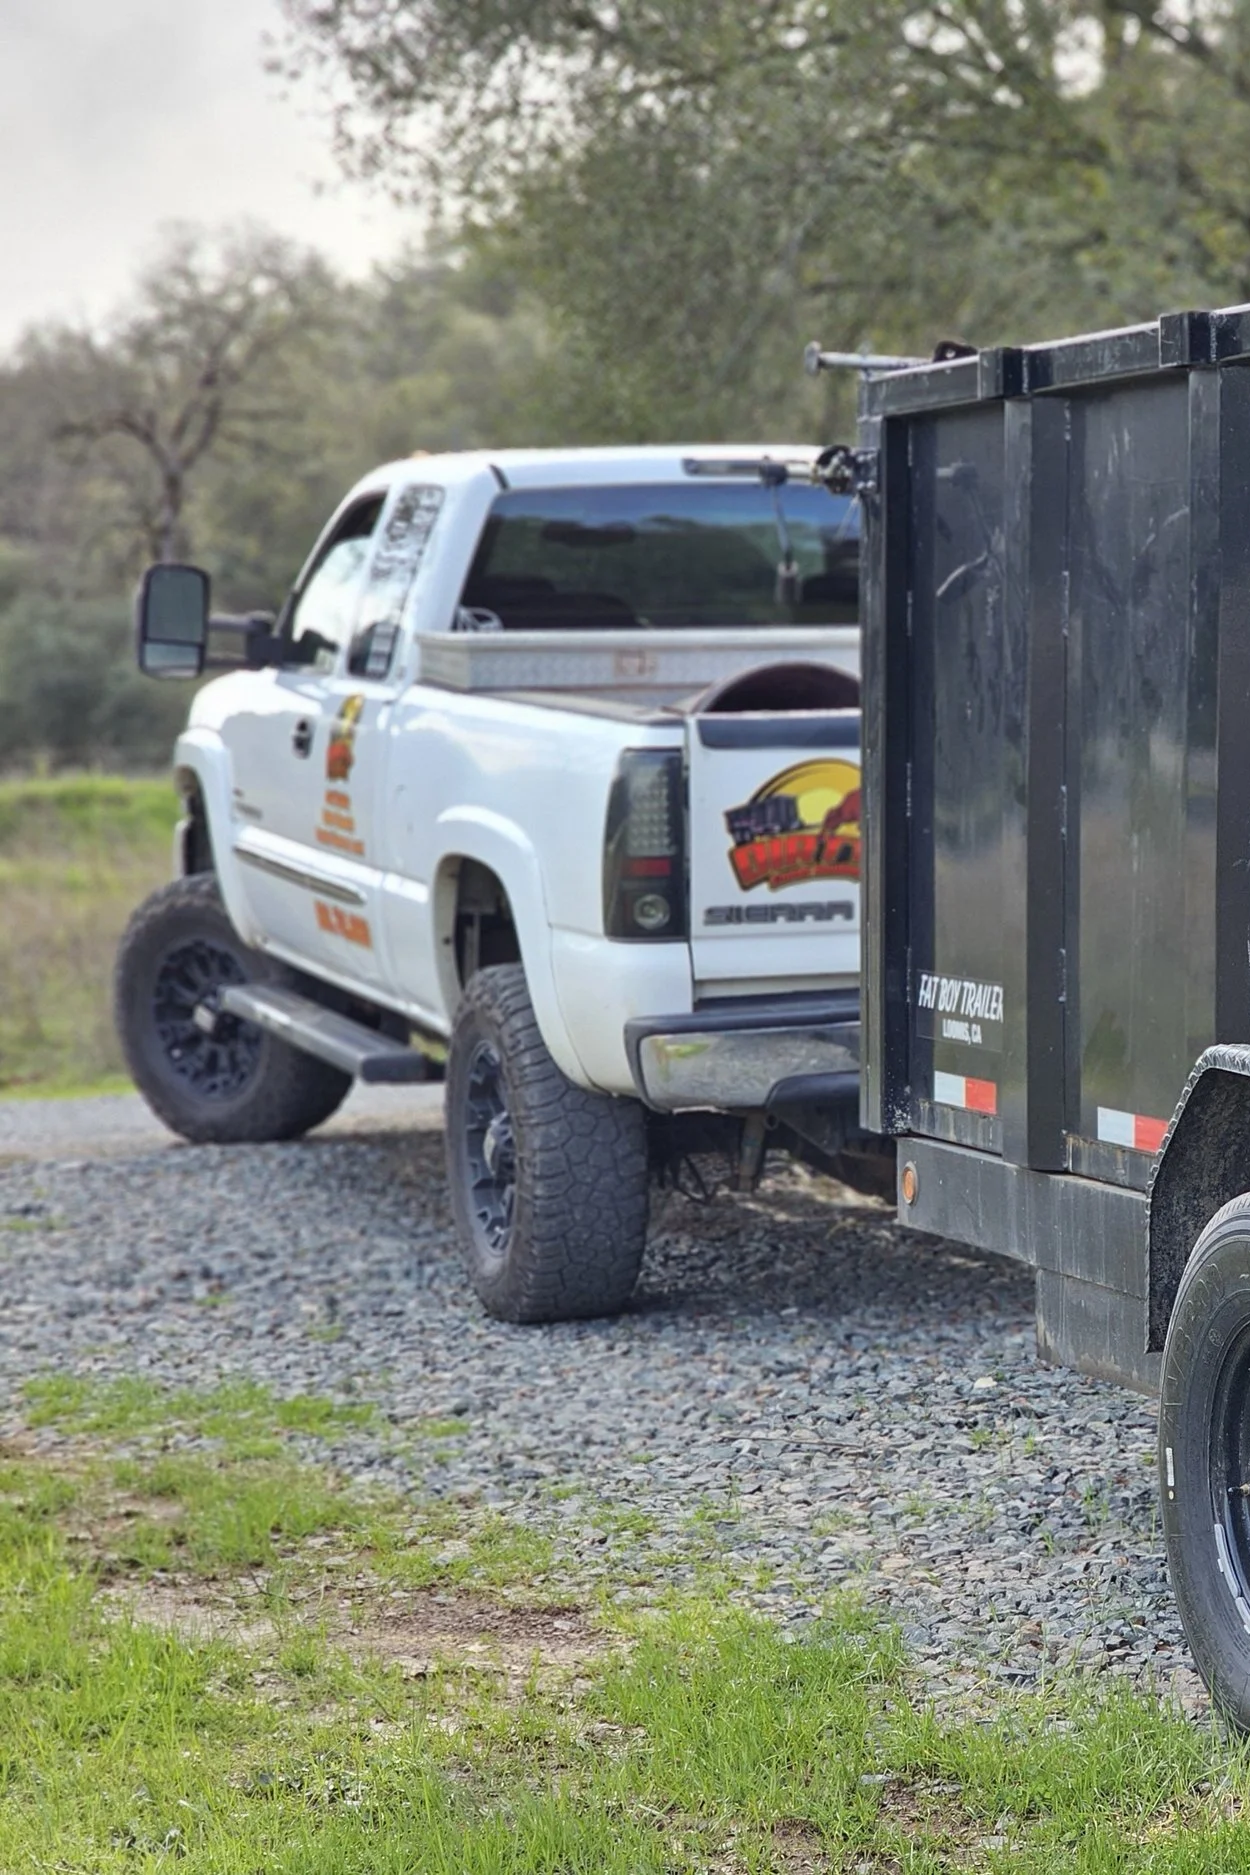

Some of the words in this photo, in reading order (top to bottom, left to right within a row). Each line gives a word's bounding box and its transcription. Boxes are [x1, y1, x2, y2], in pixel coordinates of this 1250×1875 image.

[732, 832, 862, 886] DIRT
[703, 901, 855, 926] SIERRA
[918, 974, 940, 1010] FAT
[938, 977, 961, 1013] BOY
